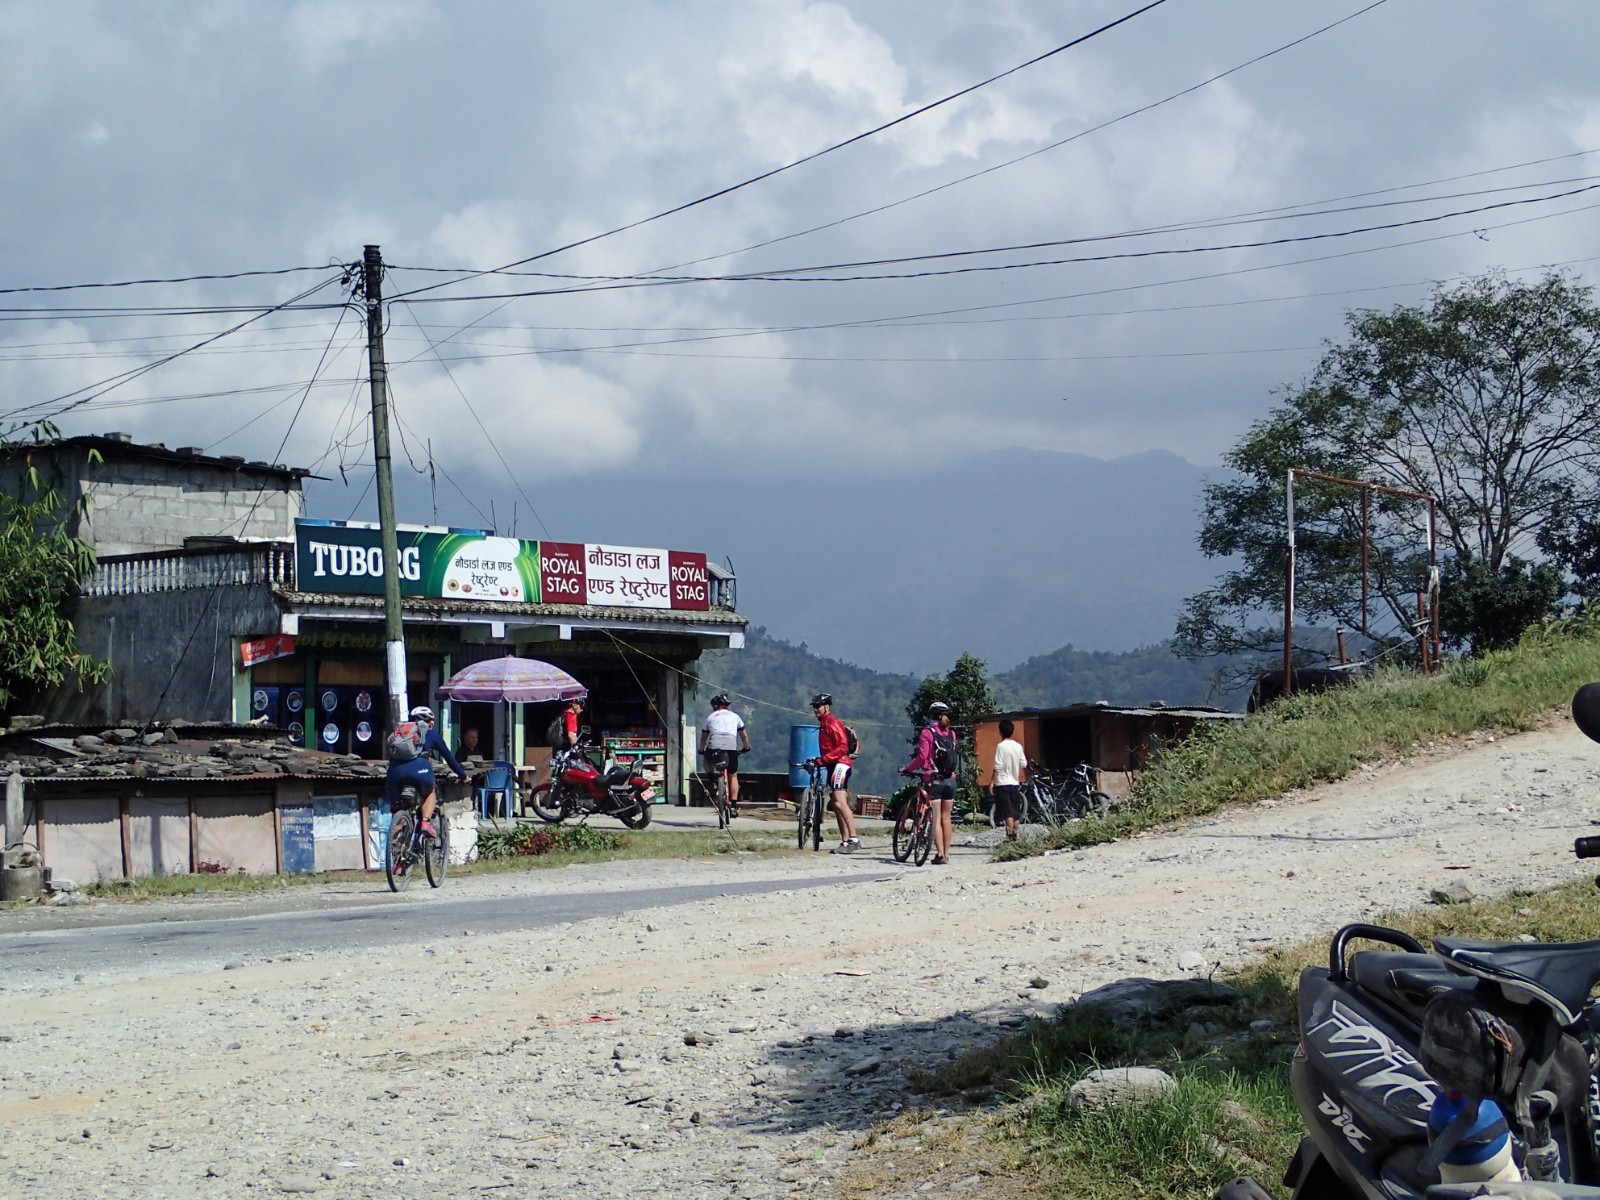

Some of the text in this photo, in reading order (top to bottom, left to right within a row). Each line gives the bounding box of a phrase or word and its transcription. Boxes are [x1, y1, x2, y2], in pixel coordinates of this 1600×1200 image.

[481, 560, 495, 570] लज
[542, 557, 583, 575] ROYAL
[588, 546, 660, 570] नौडाडा लज
[671, 566, 707, 583] ROYAL
[547, 577, 580, 594] STAG
[588, 579, 614, 595] एण्ड
[676, 585, 704, 601] STAG
